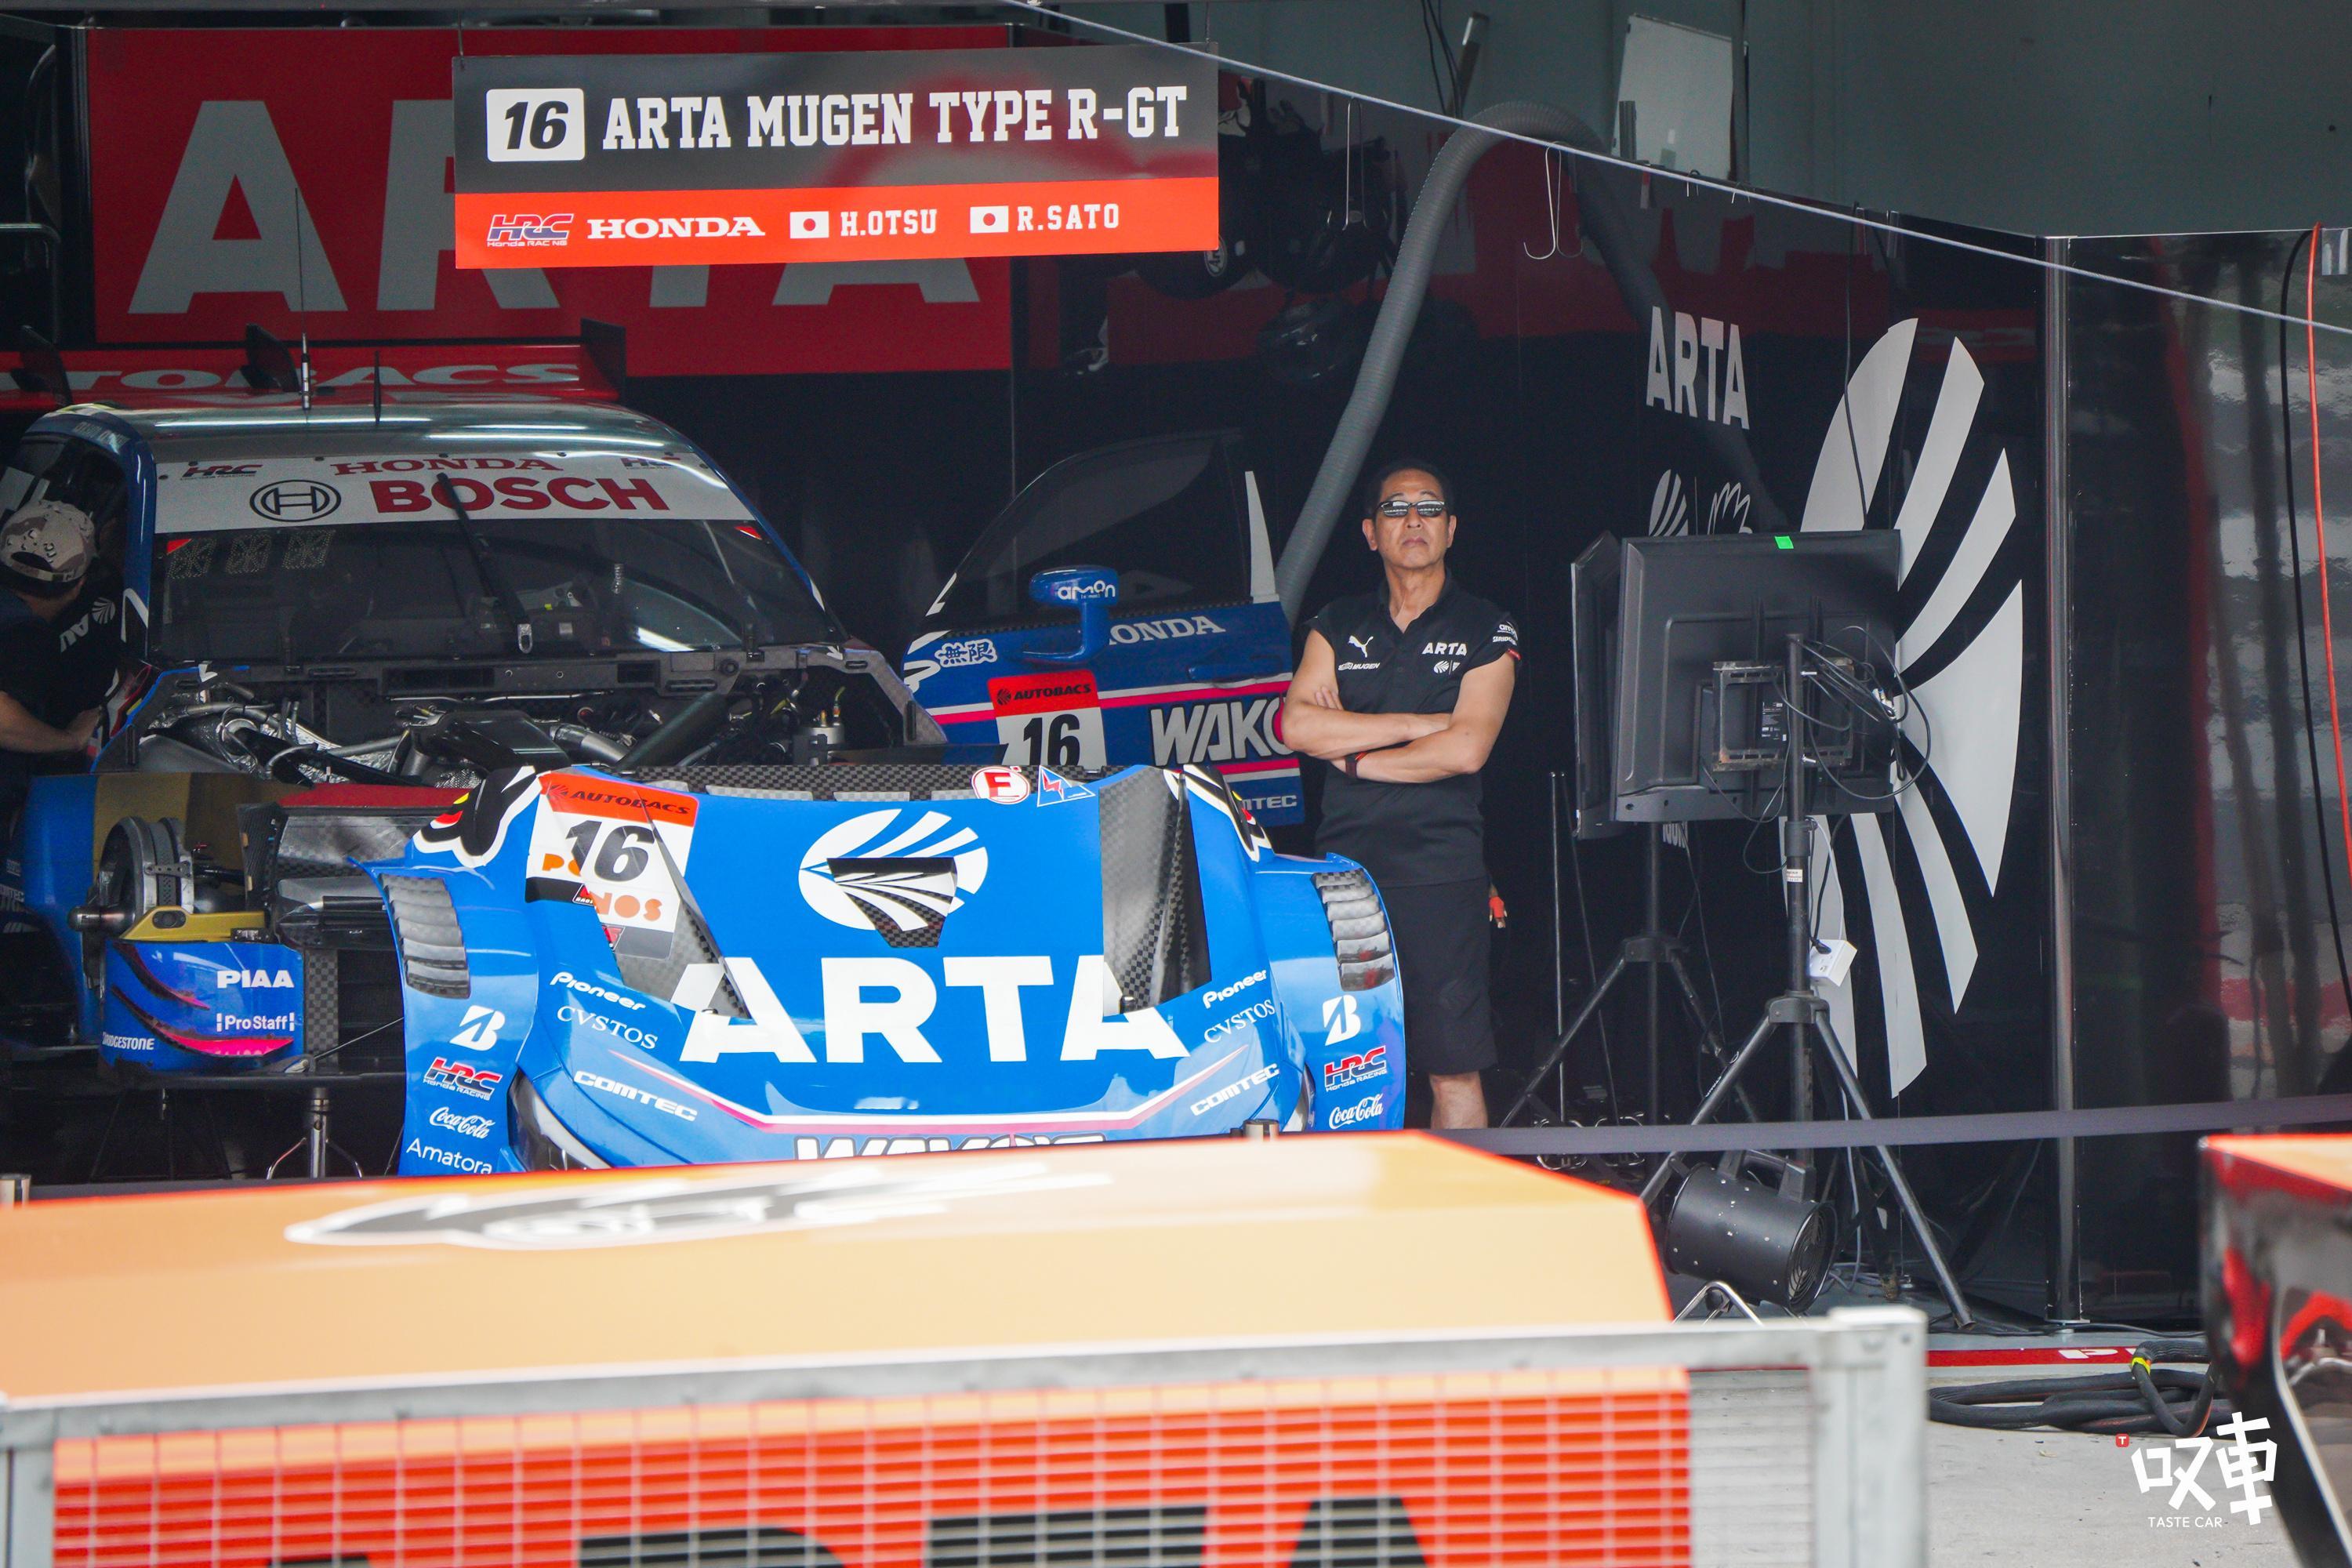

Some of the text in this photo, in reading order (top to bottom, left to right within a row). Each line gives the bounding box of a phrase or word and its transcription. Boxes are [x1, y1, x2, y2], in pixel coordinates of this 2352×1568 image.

[505, 101, 568, 149] 16
[603, 85, 1187, 150] ARTA MUGEN TYPE R-GT
[487, 212, 575, 241] HRC
[586, 216, 765, 239] HONDA
[840, 209, 938, 237] H.OTSU
[1017, 203, 1120, 232] R.SATO
[1646, 306, 1750, 430] ARTA
[331, 457, 565, 476] HONDA
[370, 476, 670, 514] BOSCH
[1109, 615, 1226, 646] ONDA
[1422, 642, 1468, 656] ARTA
[1014, 684, 1092, 702] AUTOBACS
[1022, 713, 1081, 766] 16
[570, 790, 691, 815] AUTOBACS
[565, 819, 660, 883] 16
[217, 969, 295, 989] PIAA
[550, 971, 646, 1011] Pioneer
[1202, 969, 1267, 1009] Pioneer
[670, 954, 1191, 1063] ARTA
[423, 1056, 503, 1096] HRC
[1324, 1045, 1387, 1088] HRC
[1325, 1069, 1388, 1093] Honda RACING
[423, 1078, 491, 1101] Honda RACING
[574, 1069, 698, 1121] COMTEC
[1190, 1062, 1280, 1116] COMTEC
[406, 1138, 492, 1174] Amatora
